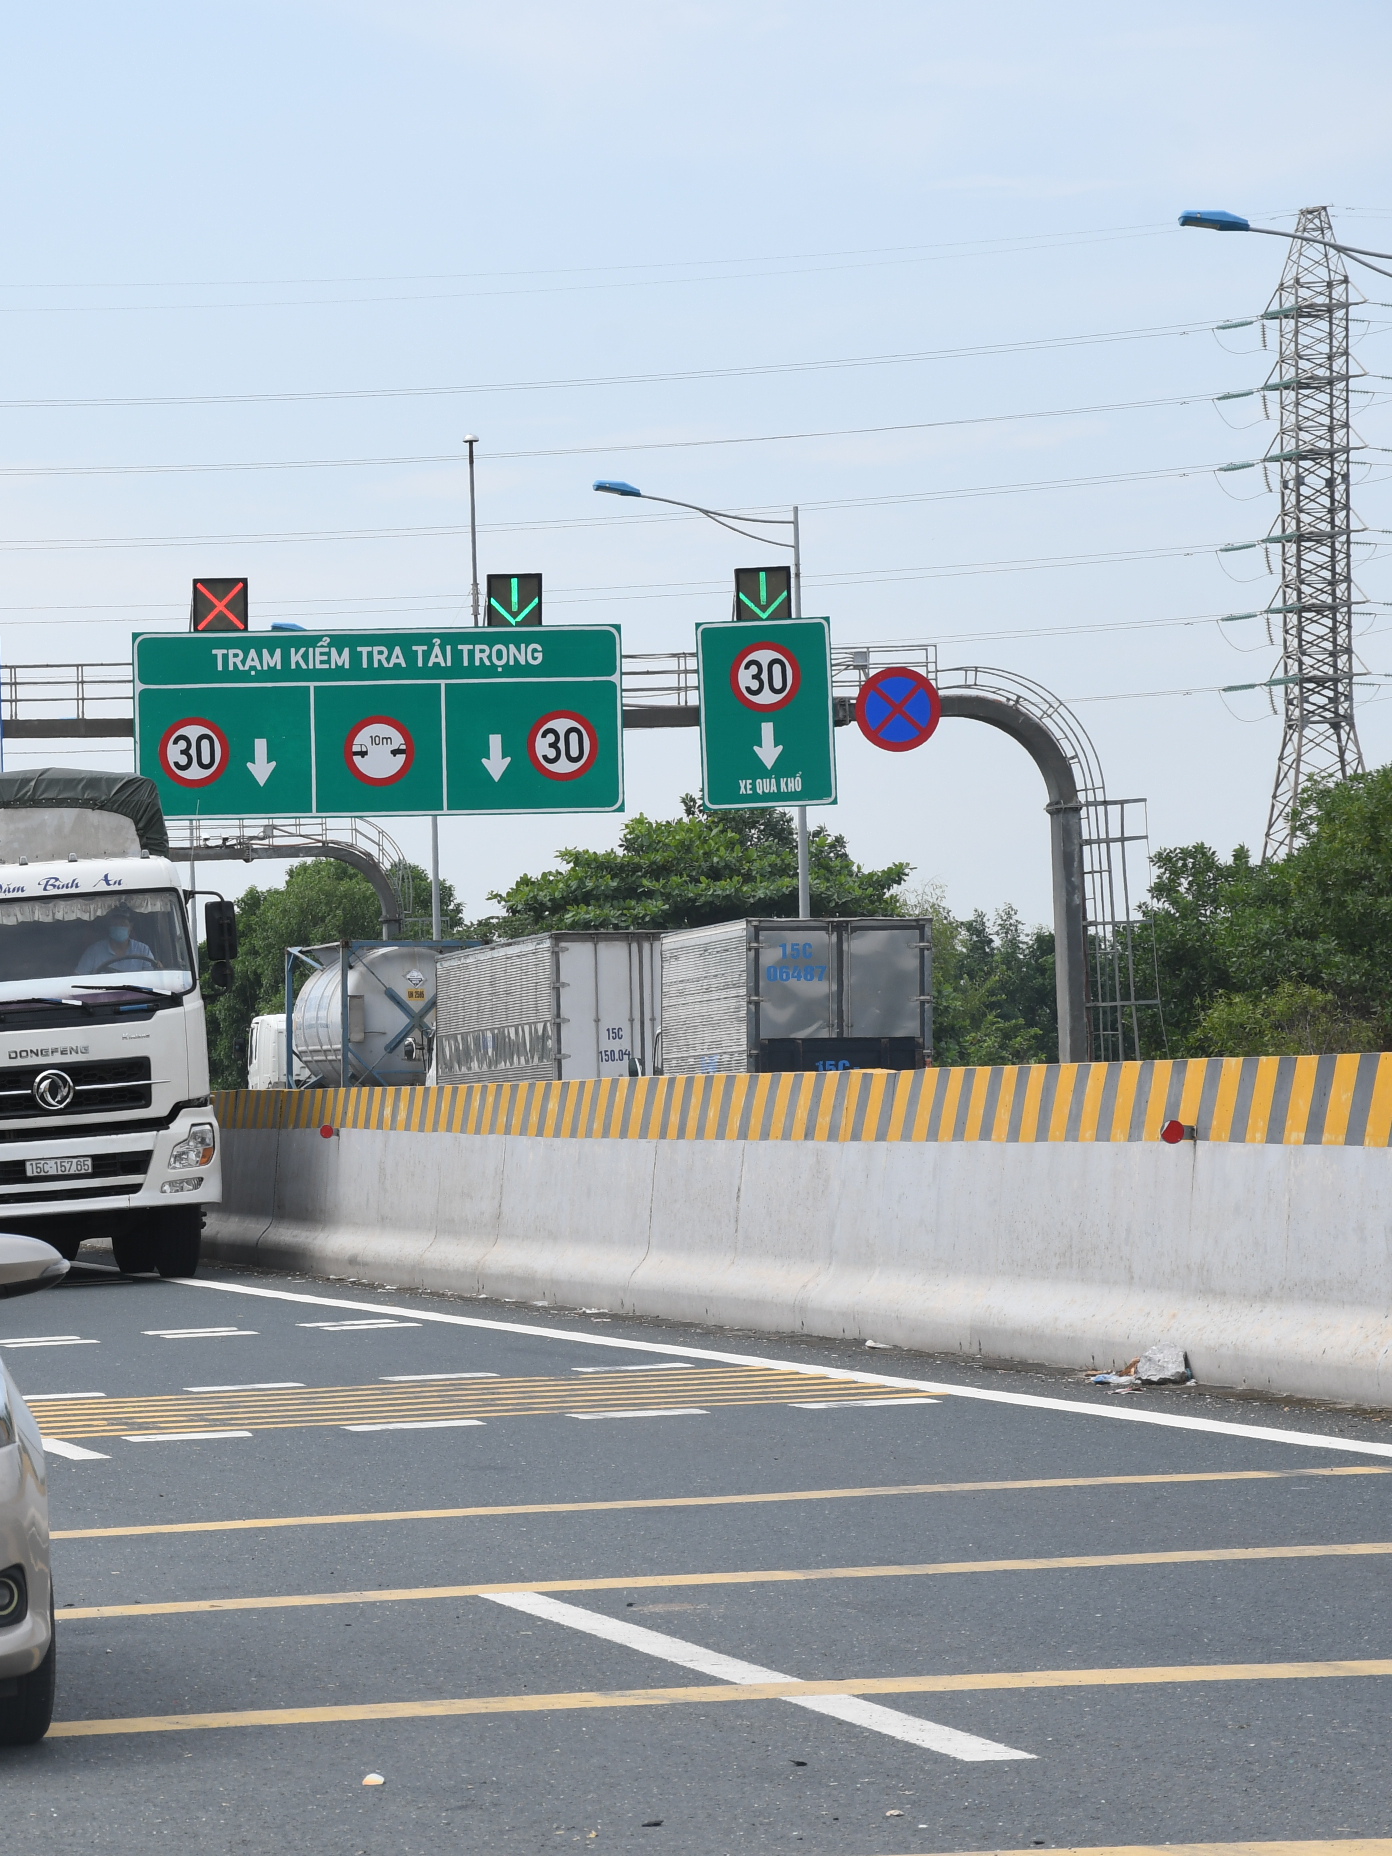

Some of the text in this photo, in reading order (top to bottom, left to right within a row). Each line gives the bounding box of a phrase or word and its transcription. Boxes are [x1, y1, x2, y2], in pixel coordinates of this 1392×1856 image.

[212, 637, 544, 675] TRẠM KIỂM TRA TẢI TRỌNG
[744, 658, 788, 696] 30
[369, 735, 393, 746] 10m
[541, 726, 585, 764] 30
[172, 733, 216, 771] 30
[739, 771, 802, 795] XE QUÁ KHỔ
[37, 876, 81, 892] Bình
[92, 872, 123, 888] An
[778, 942, 814, 960] 15C
[766, 965, 828, 982] 06487
[606, 1027, 624, 1040] 15C
[8, 1045, 90, 1060] DONGFENG
[598, 1049, 631, 1063] 150.04
[29, 1160, 90, 1175] 15C-157.65
